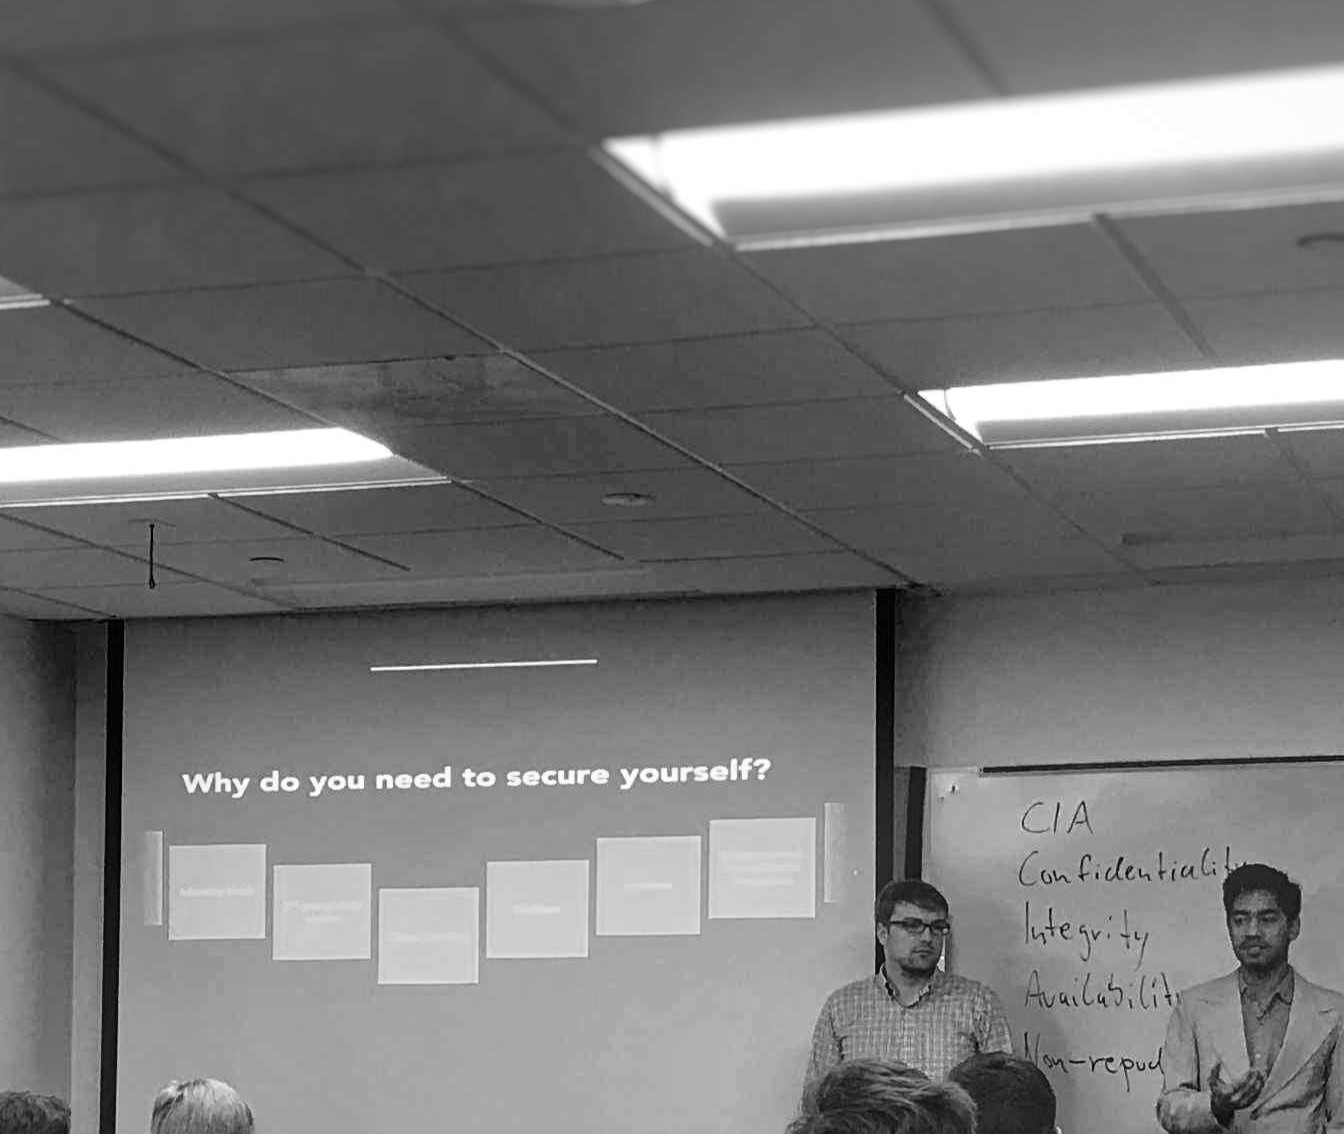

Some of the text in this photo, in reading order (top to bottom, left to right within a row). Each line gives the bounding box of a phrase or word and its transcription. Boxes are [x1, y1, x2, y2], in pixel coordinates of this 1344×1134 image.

[182, 757, 772, 798] Why do you need to secure yourself?
[1021, 800, 1093, 834] CIA
[1018, 846, 1247, 886] Confidentialit
[1024, 900, 1149, 971] Integrity
